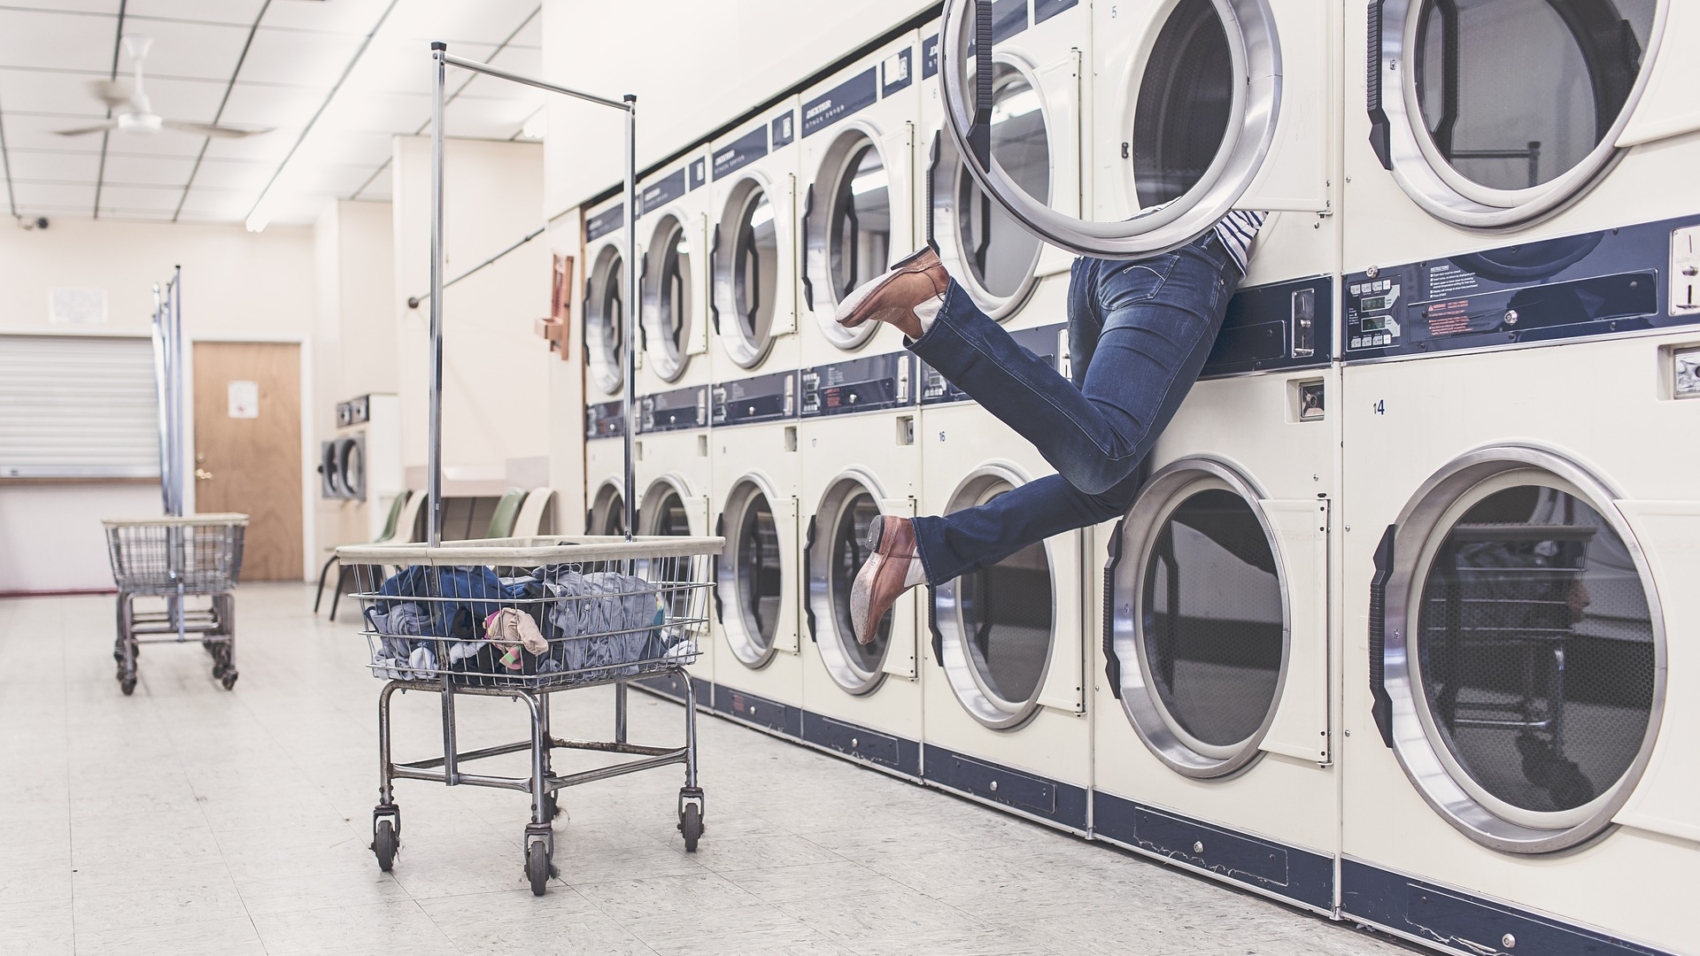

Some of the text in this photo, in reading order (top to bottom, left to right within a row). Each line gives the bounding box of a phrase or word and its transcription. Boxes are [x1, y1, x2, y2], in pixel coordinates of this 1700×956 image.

[1112, 5, 1117, 19] 5
[1373, 399, 1385, 415] 14
[939, 431, 946, 442] 16
